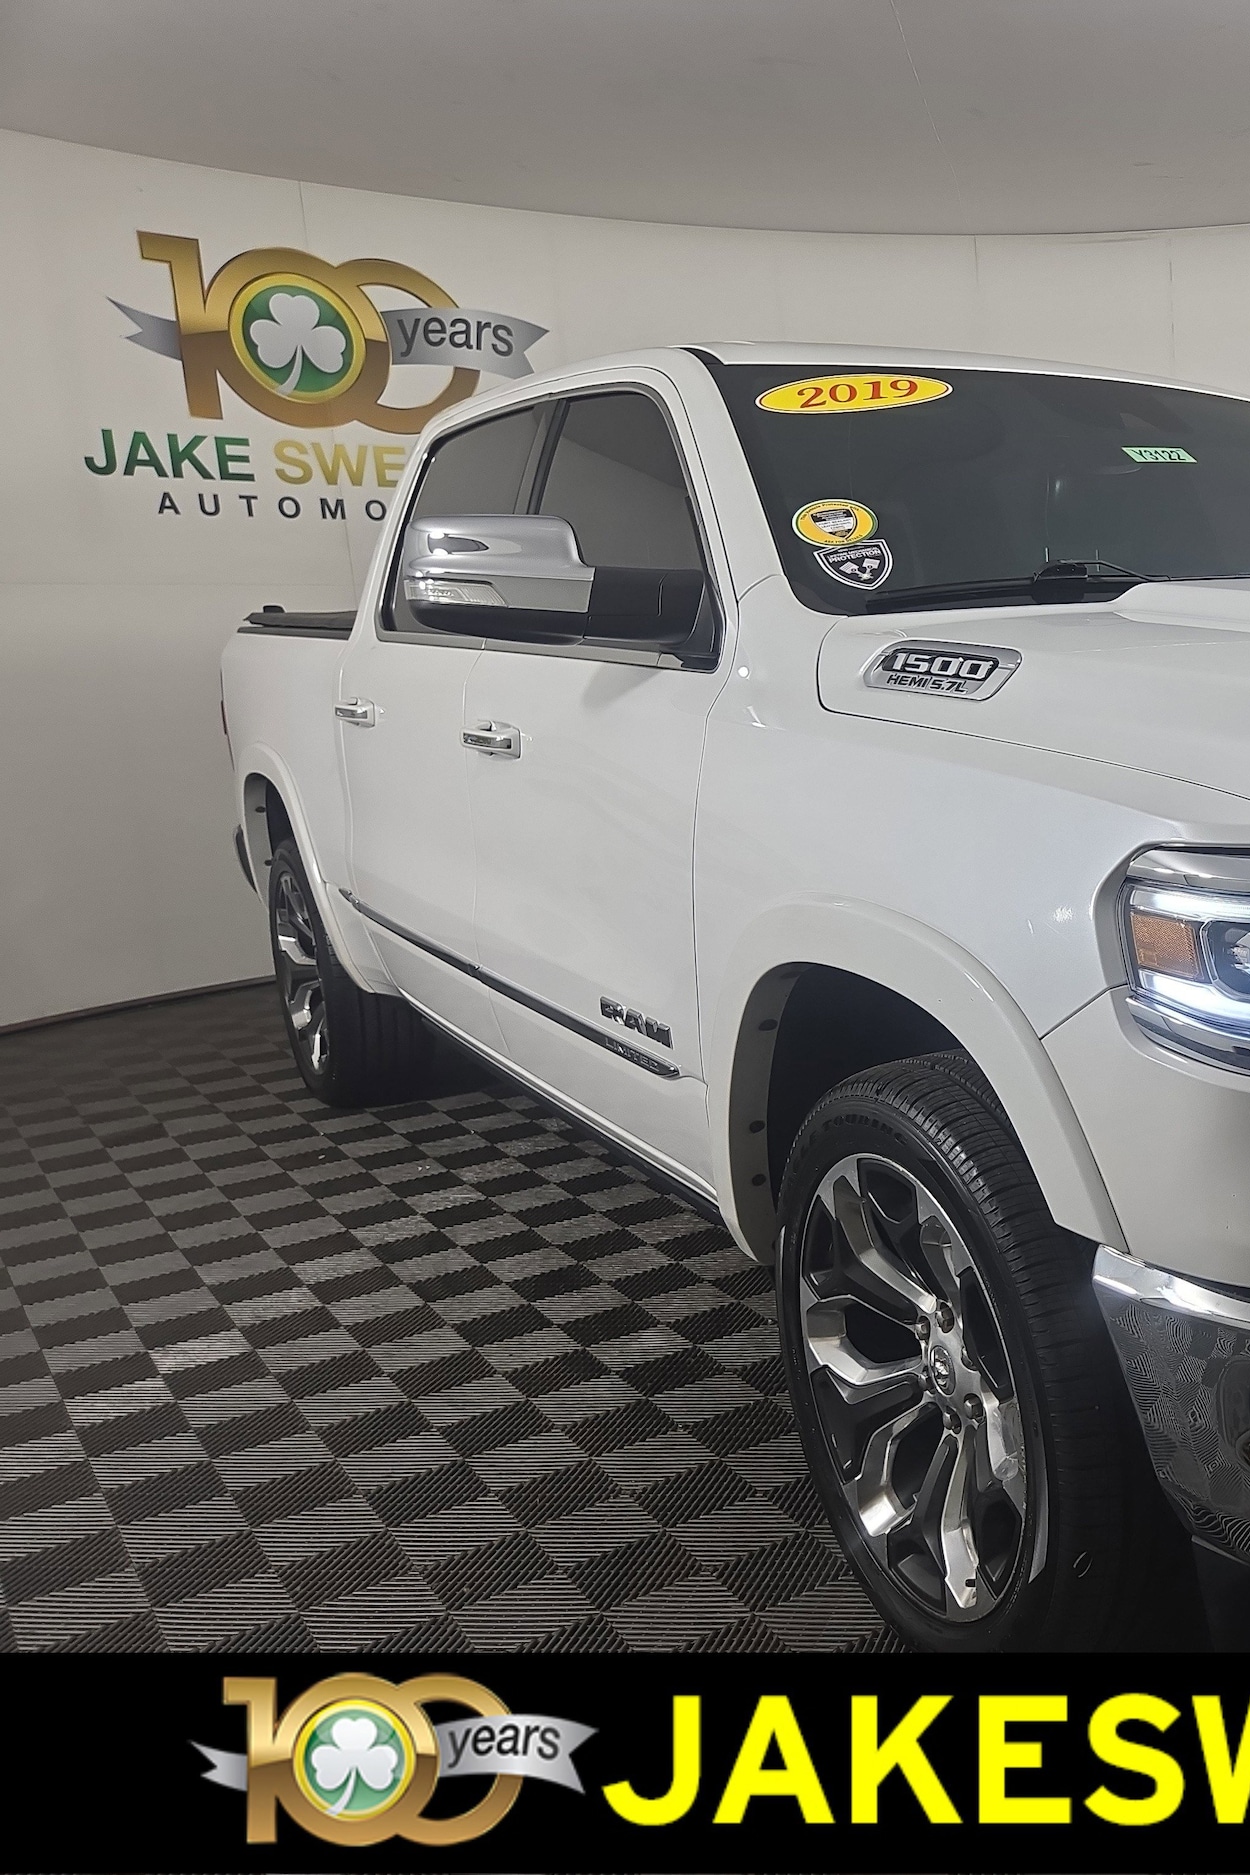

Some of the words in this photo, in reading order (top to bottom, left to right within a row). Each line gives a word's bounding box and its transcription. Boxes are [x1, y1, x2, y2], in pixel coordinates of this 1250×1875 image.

[136, 230, 480, 434] 100
[397, 314, 516, 358] years
[797, 378, 919, 409] 2019
[84, 428, 256, 482] JAKE
[1131, 450, 1187, 461] Y3122
[157, 491, 388, 521] AUTOMO
[828, 548, 881, 564] PROTECTION
[891, 652, 994, 680] 1500
[886, 673, 928, 688] HEMI
[929, 677, 967, 694] 5.7L
[600, 995, 674, 1050] RAM
